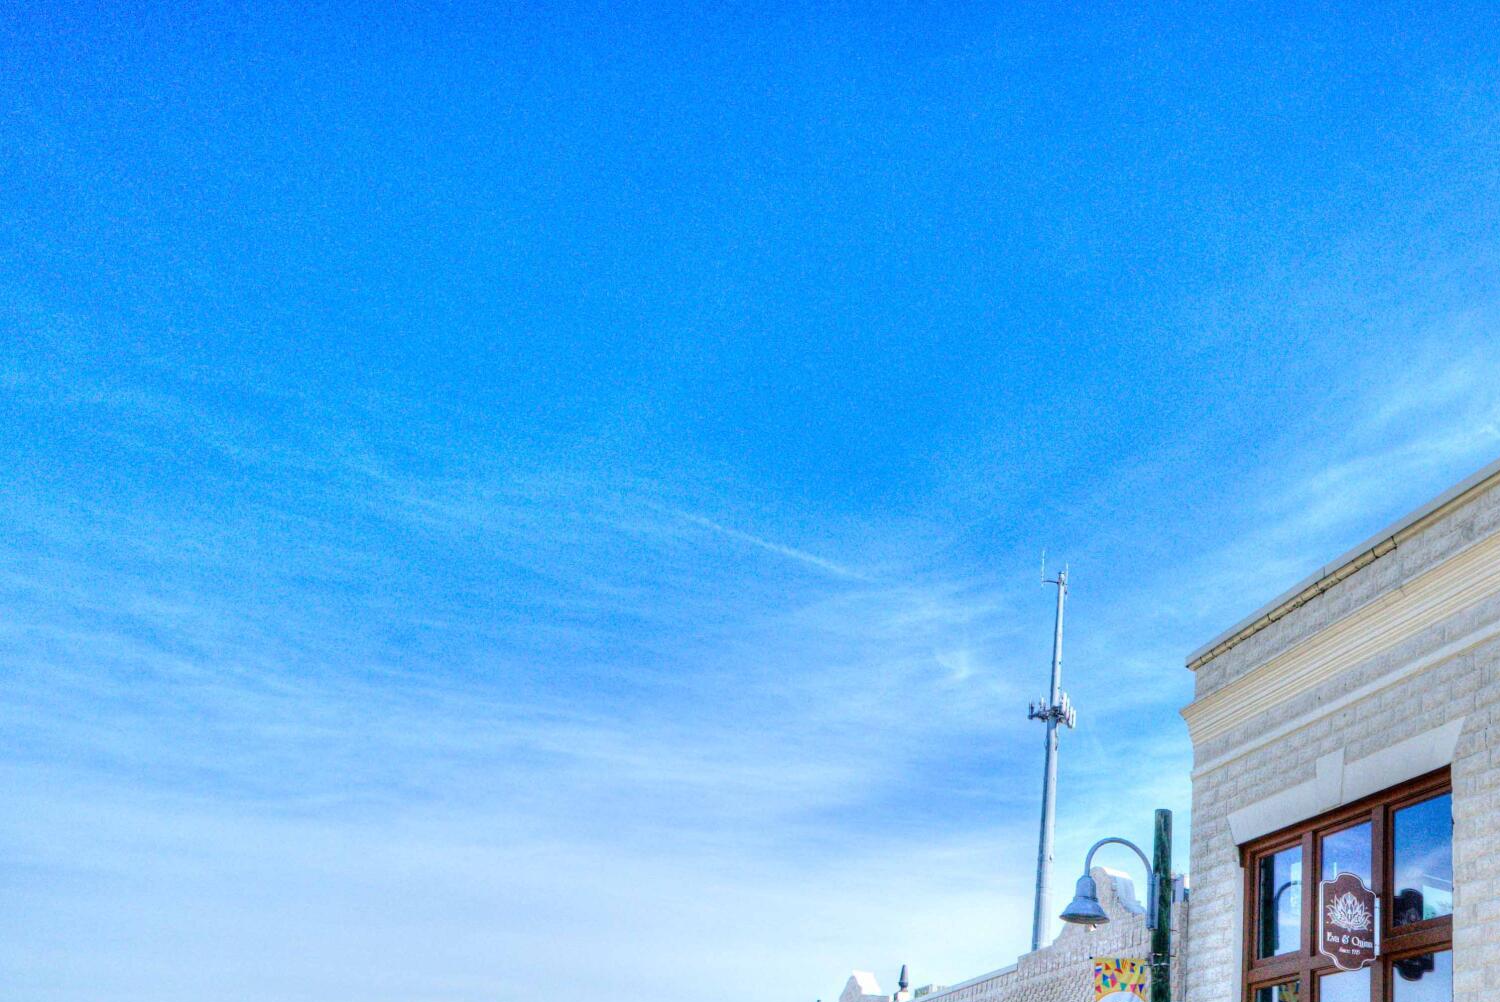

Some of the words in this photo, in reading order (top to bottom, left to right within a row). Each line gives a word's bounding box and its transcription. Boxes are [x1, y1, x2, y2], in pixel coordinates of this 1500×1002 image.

[1327, 931, 1340, 943] Eva
[1341, 934, 1350, 944] &
[1352, 936, 1373, 948] Quinn
